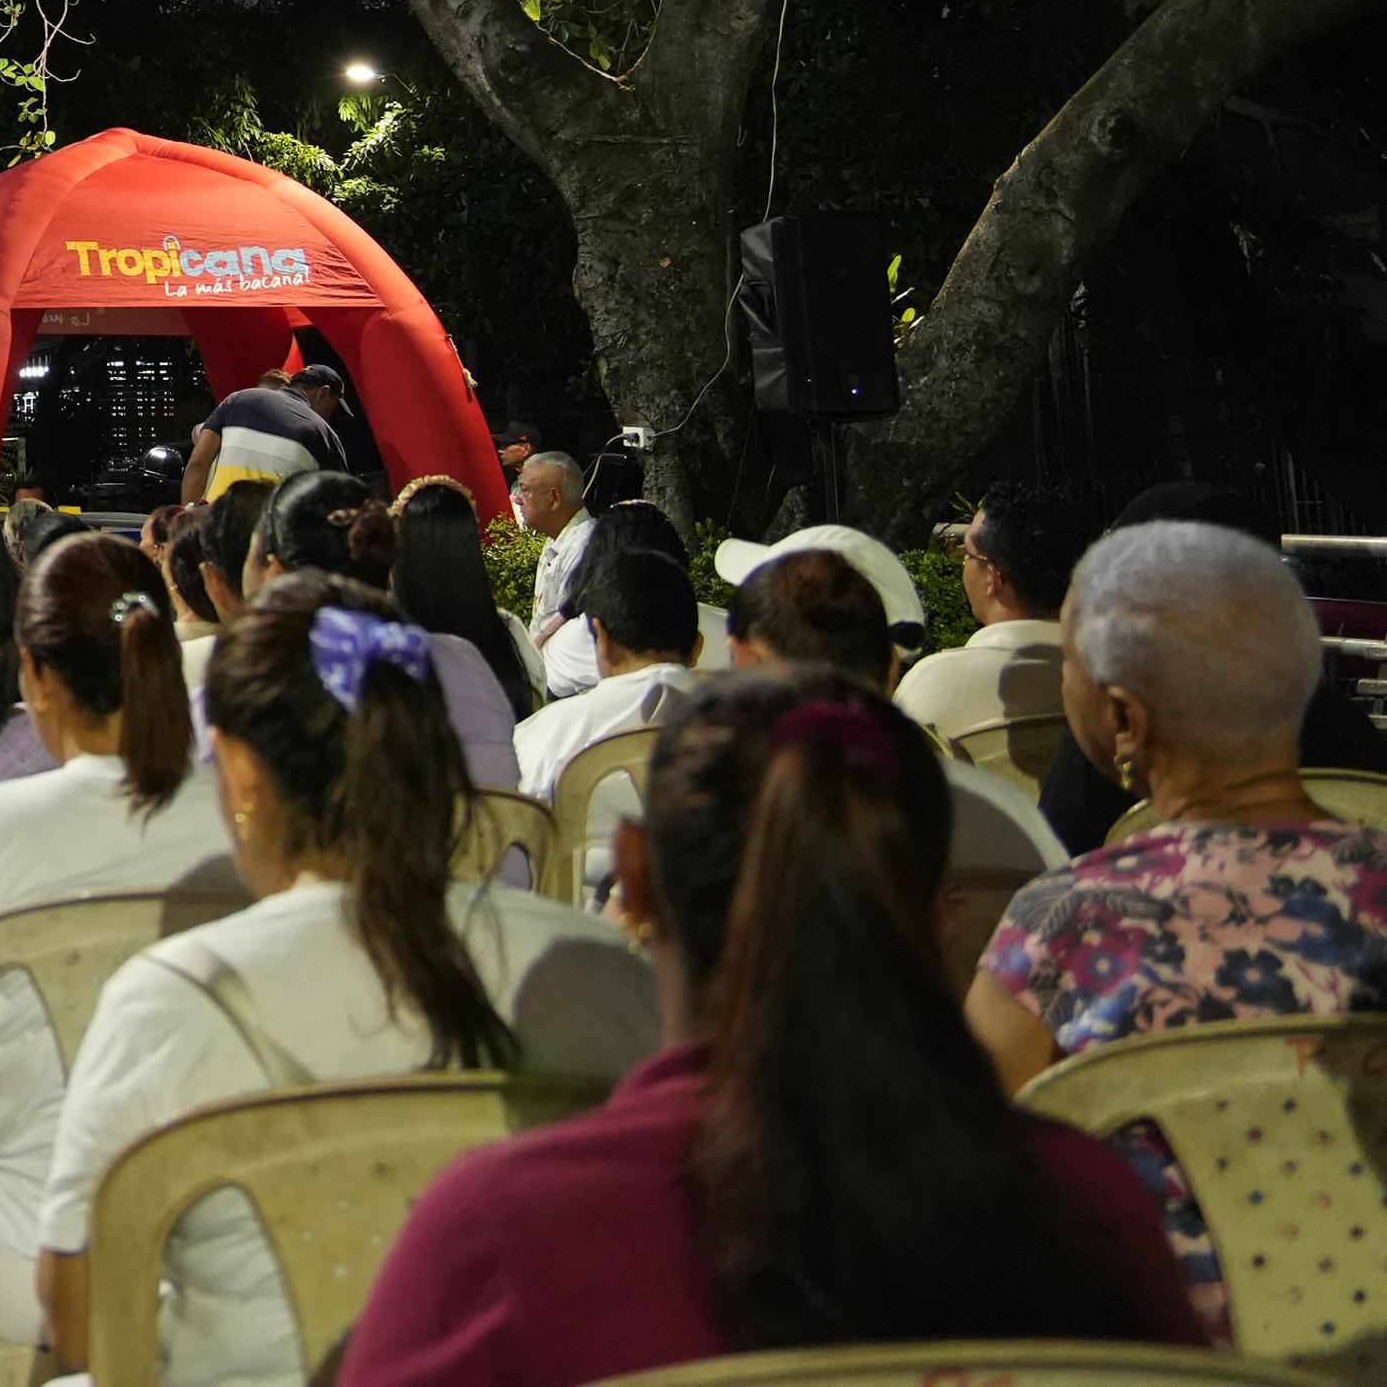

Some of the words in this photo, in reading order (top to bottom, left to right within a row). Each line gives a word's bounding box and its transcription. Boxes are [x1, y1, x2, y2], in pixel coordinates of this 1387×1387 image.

[65, 240, 307, 284] Tropicana
[164, 281, 188, 297] La
[195, 277, 233, 294] más
[239, 266, 311, 291] bacana!
